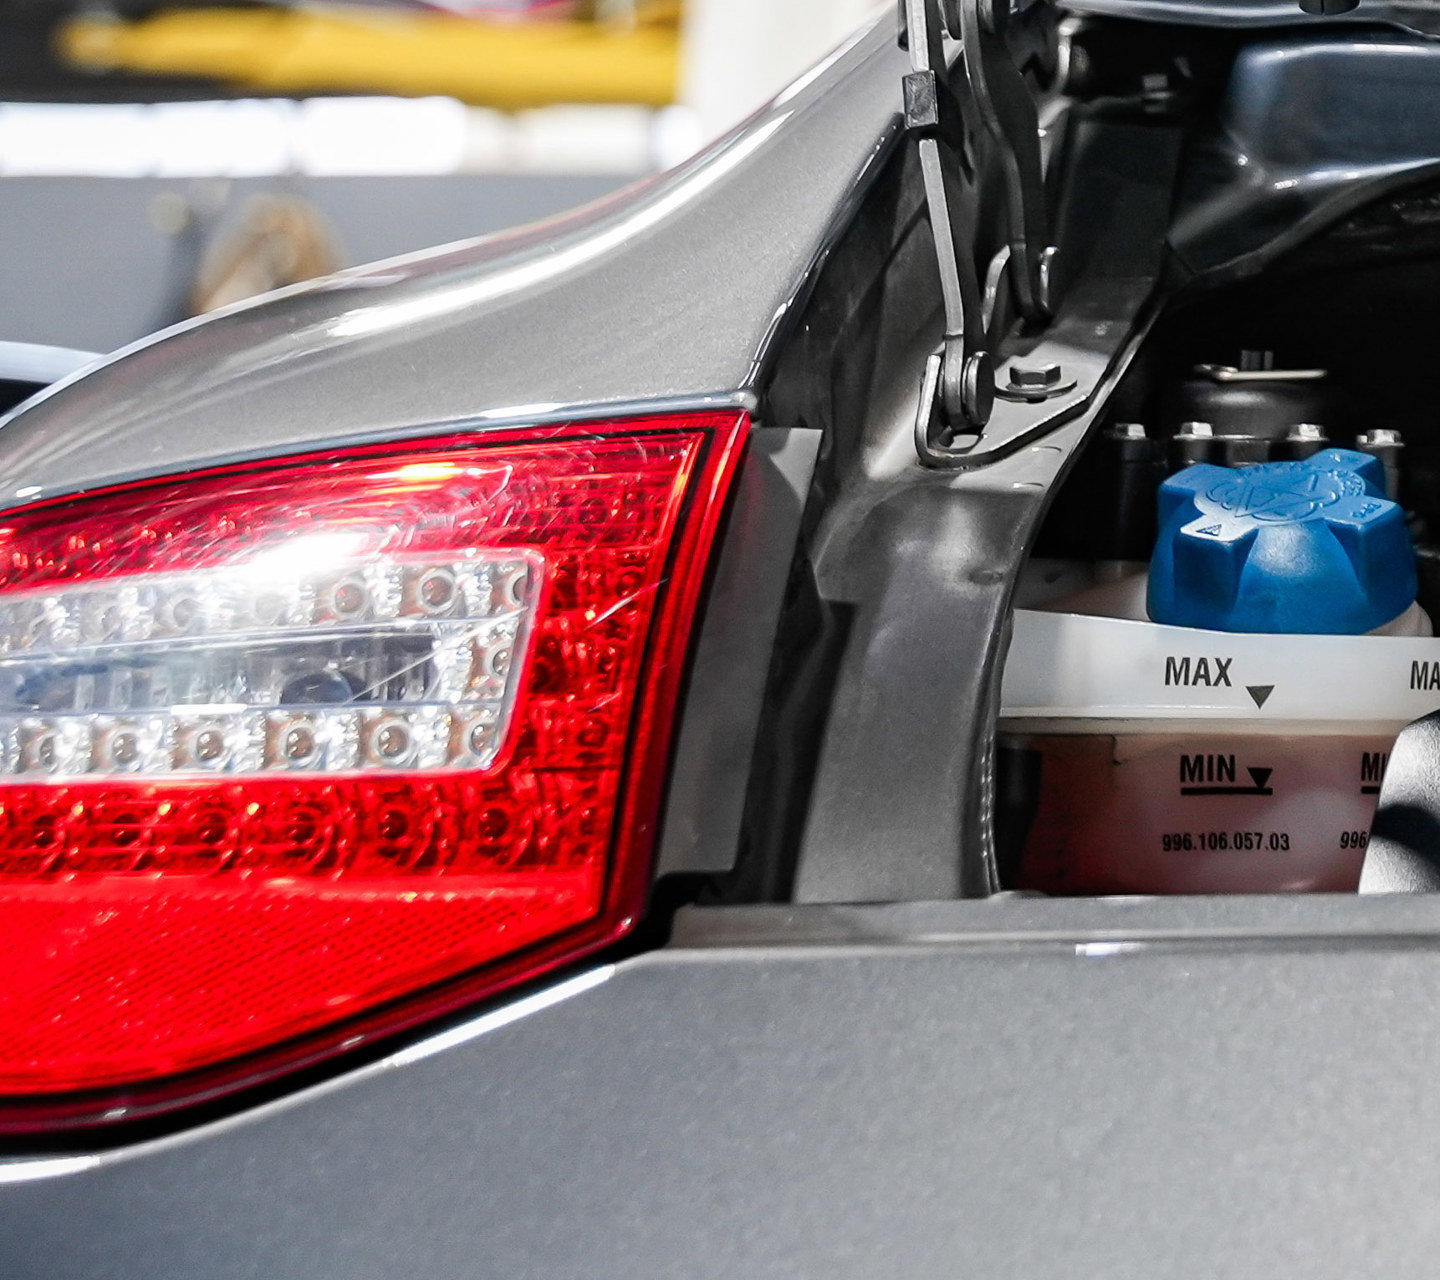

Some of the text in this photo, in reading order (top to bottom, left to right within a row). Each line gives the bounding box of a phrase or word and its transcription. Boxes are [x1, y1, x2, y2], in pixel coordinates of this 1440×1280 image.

[1164, 656, 1233, 687] MAX
[1179, 754, 1236, 784] MIN
[1361, 751, 1388, 782] MI
[1162, 831, 1290, 852] 996.106.057.03
